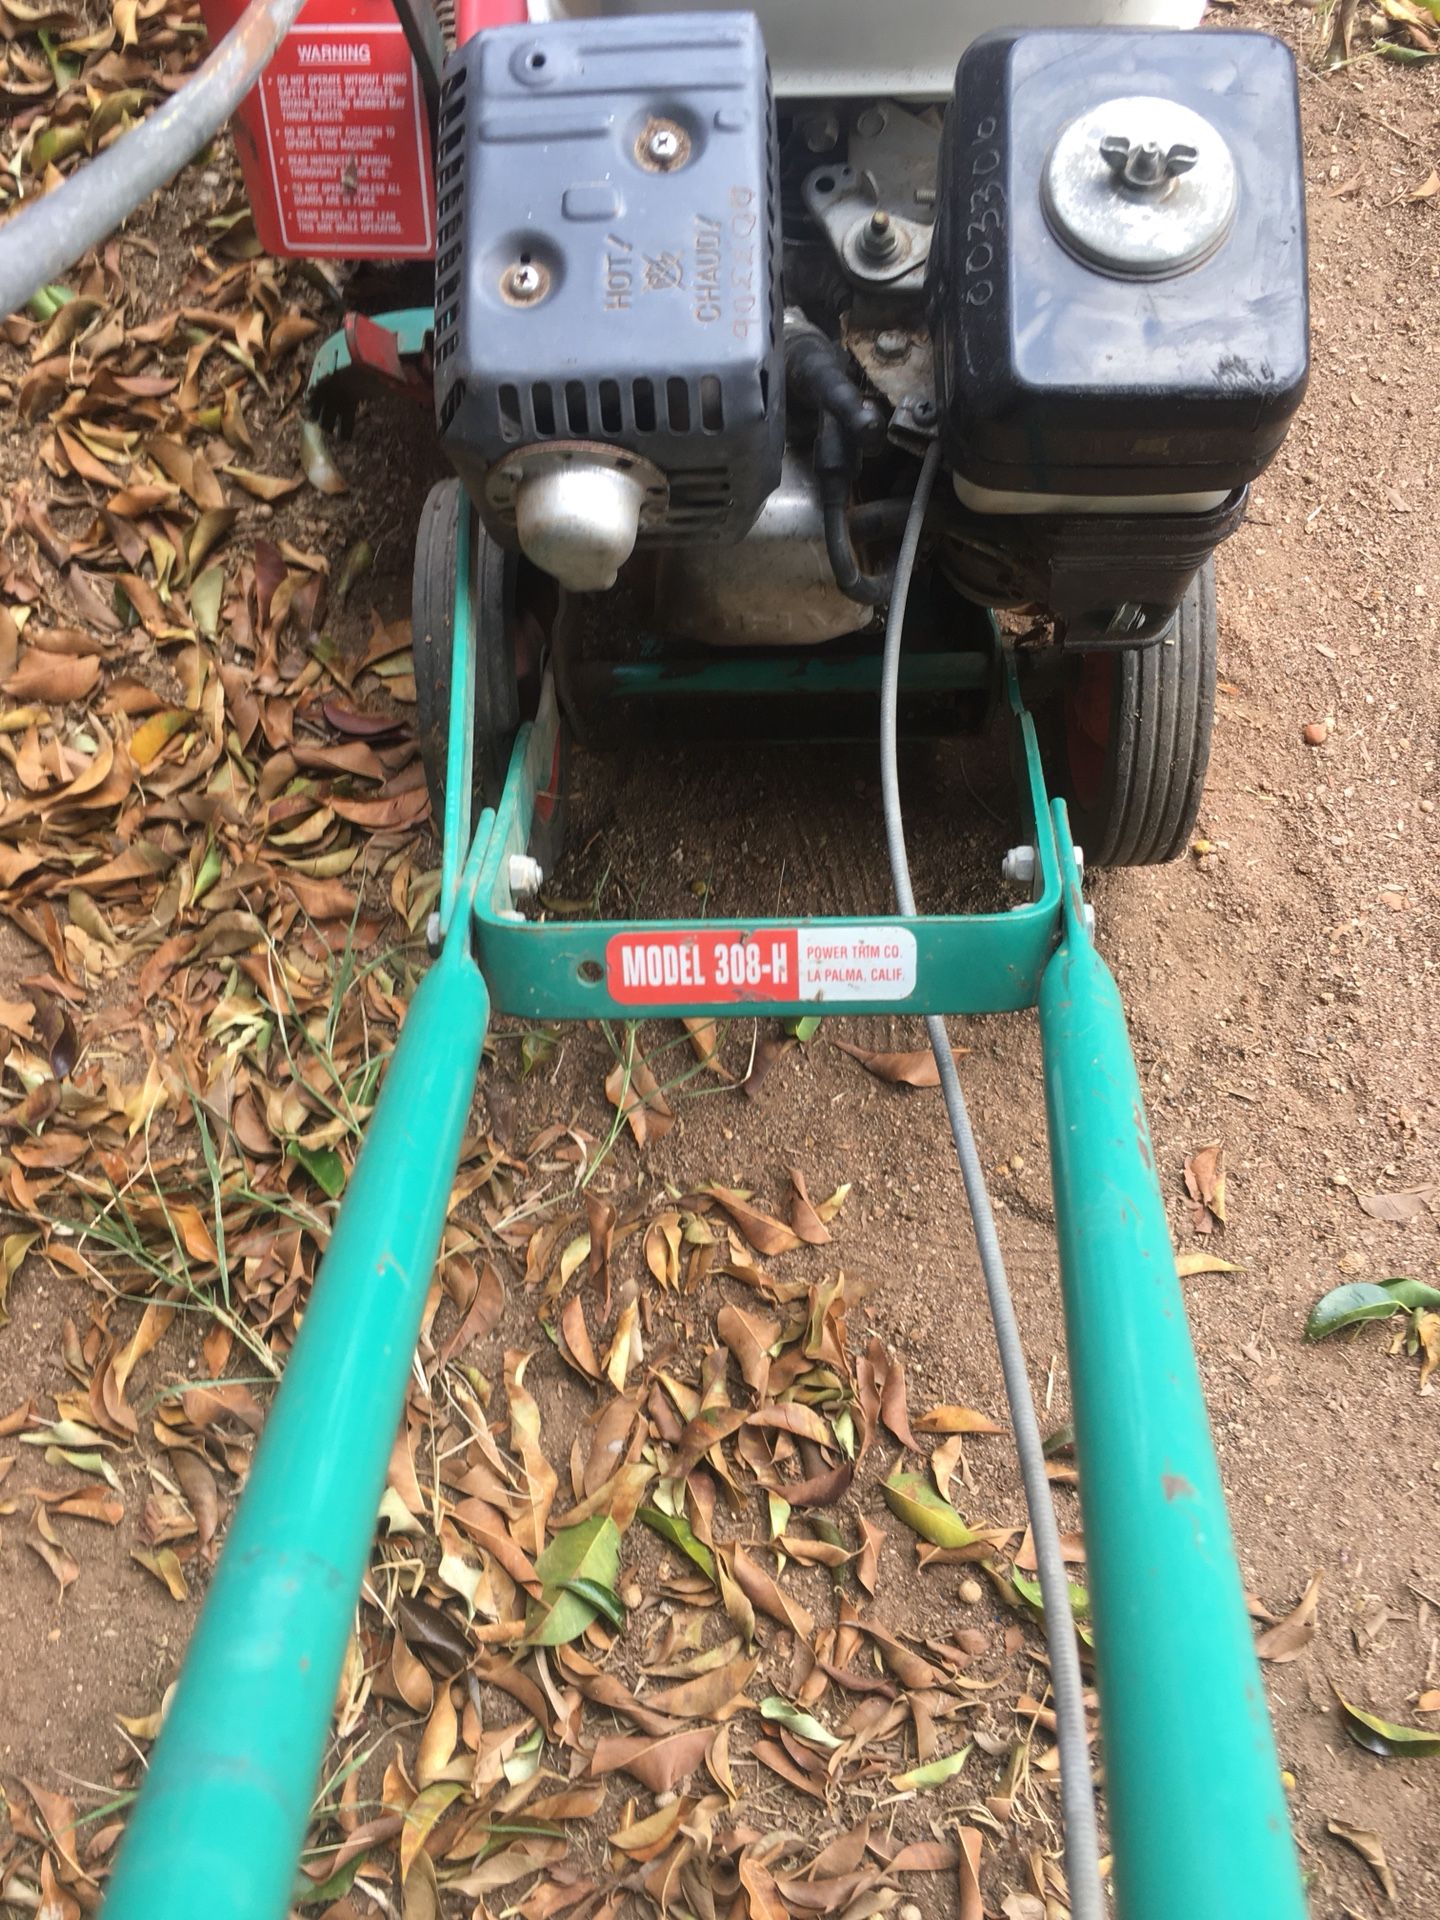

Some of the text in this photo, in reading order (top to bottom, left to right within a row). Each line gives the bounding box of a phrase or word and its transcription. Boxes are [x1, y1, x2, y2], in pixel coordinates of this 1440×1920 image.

[297, 44, 371, 63] WARNING
[291, 74, 304, 85] NOT
[308, 74, 340, 85] OPERATE
[344, 74, 379, 85] WITHOUT
[298, 127, 311, 138] NOT
[315, 127, 341, 138] PERMIT
[345, 127, 382, 138] CHILDREN
[386, 127, 395, 138] TO
[604, 233, 632, 311] HOT!
[695, 213, 721, 323] CHAUD!
[807, 944, 903, 960] POWER TRIM CO.
[621, 942, 788, 987] MODEL 308-H
[807, 966, 905, 982] LA PALMA, CALIF.
